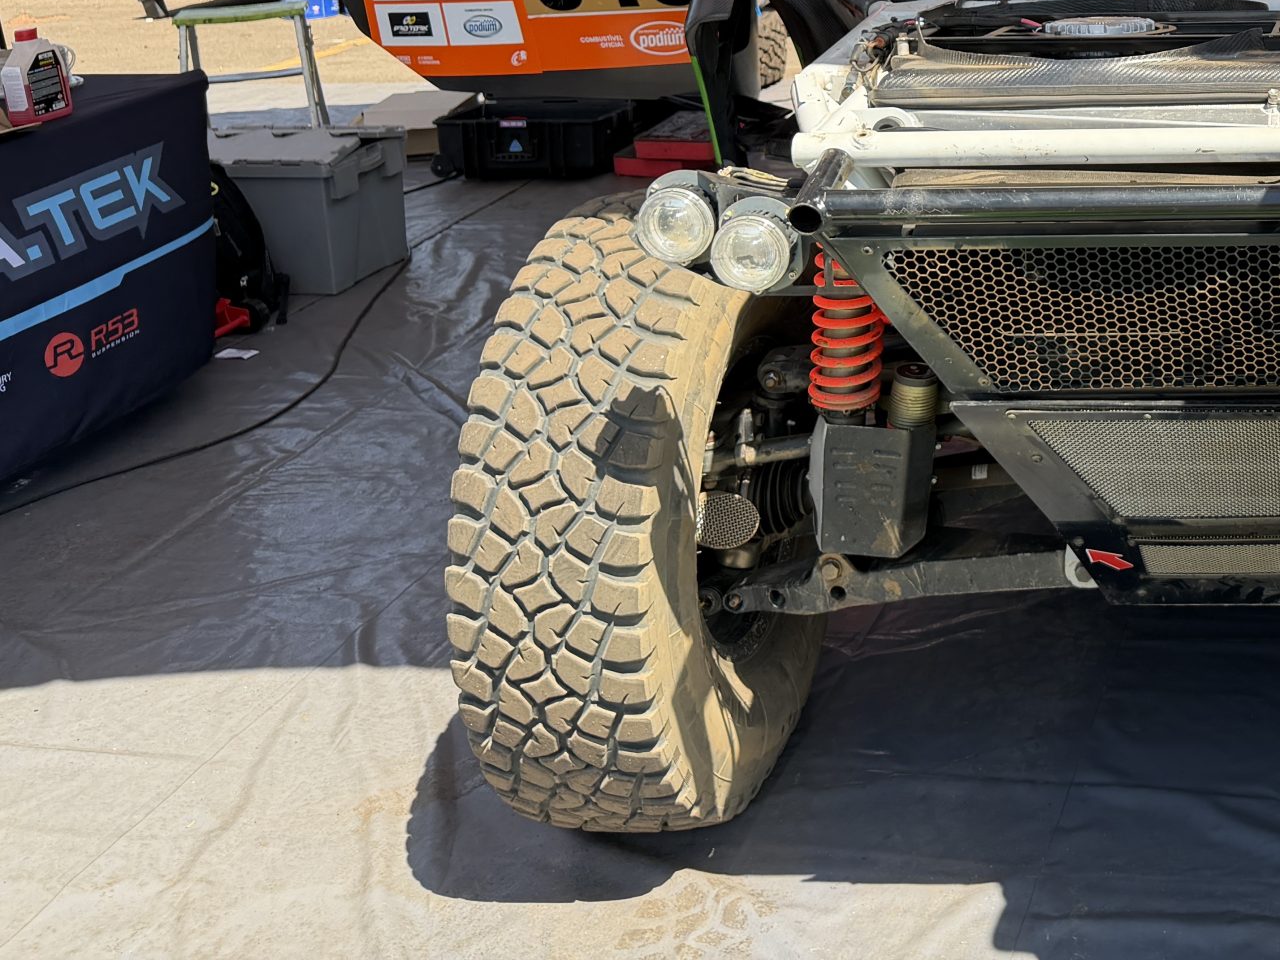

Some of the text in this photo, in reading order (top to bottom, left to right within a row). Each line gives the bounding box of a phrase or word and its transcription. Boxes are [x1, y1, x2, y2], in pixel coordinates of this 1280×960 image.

[468, 20, 498, 33] podium
[90, 307, 140, 352] R53
[91, 329, 141, 358] SUSPENSION
